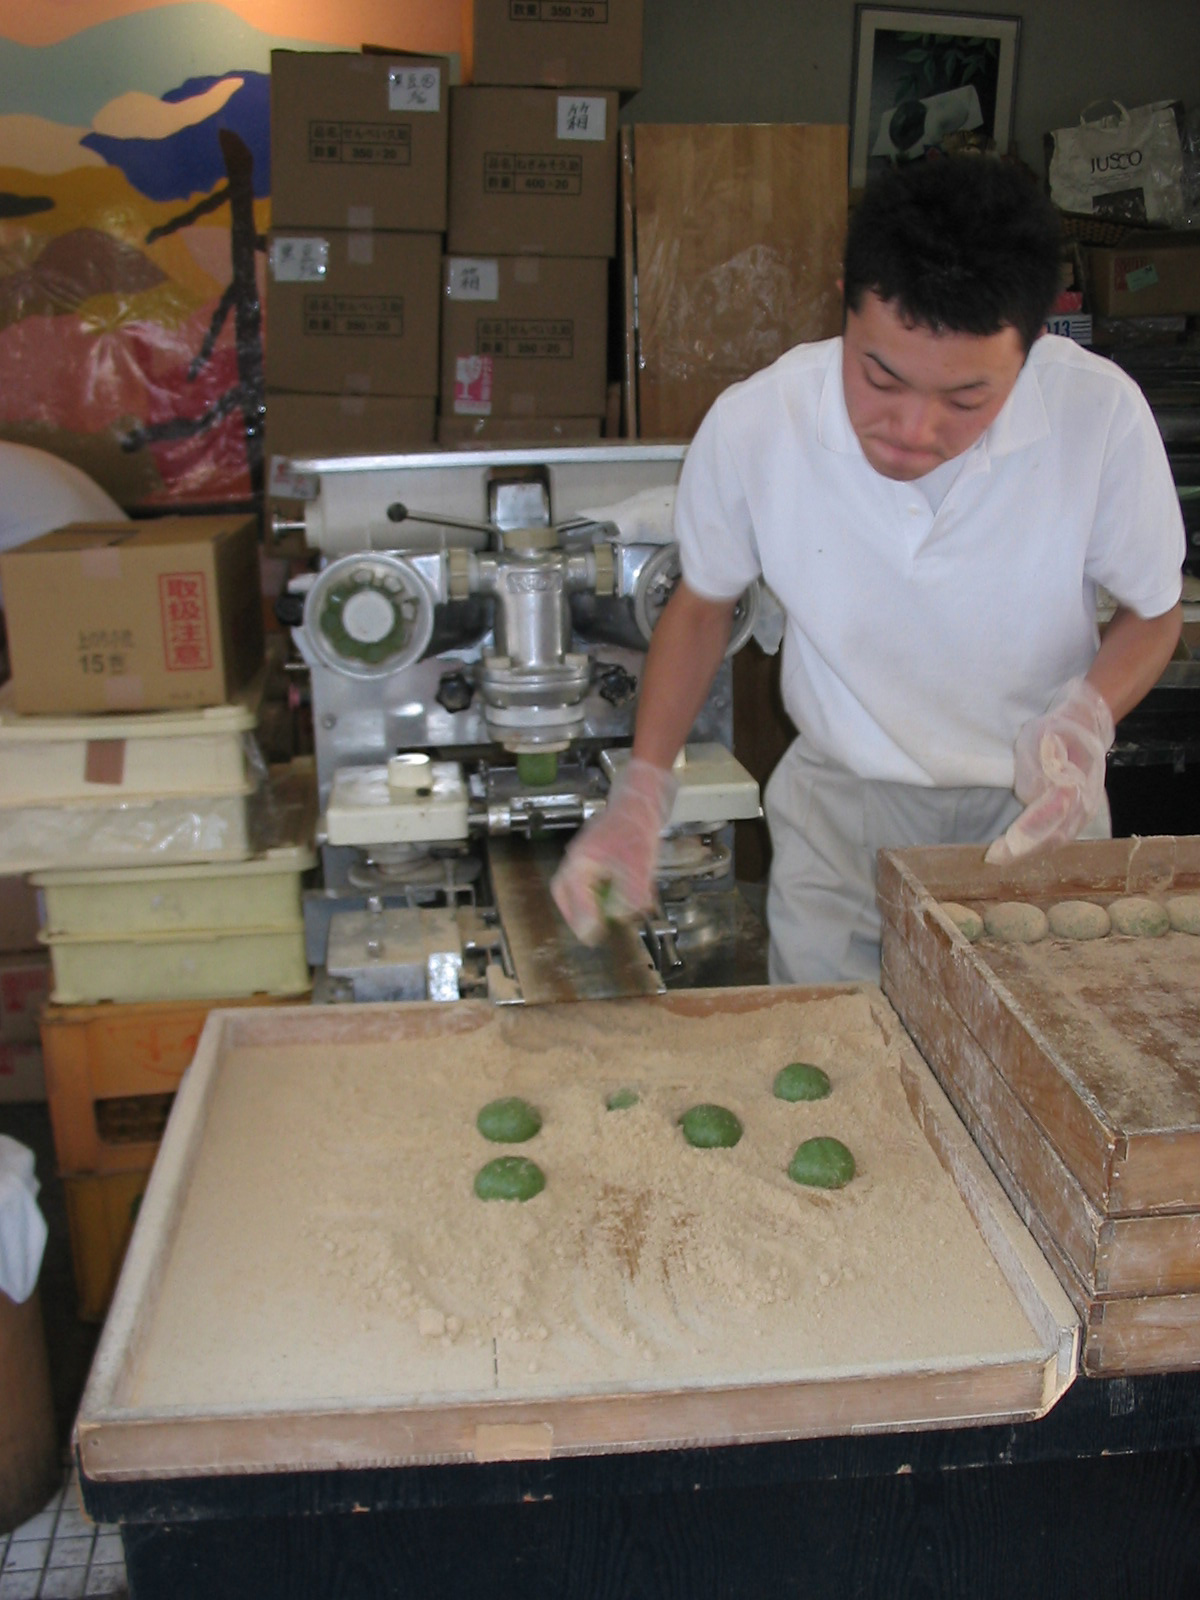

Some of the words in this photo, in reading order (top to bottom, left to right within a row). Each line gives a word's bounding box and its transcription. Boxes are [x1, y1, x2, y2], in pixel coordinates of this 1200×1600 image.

[1090, 150, 1143, 173] JUSCO
[167, 578, 202, 665] 取扱注意
